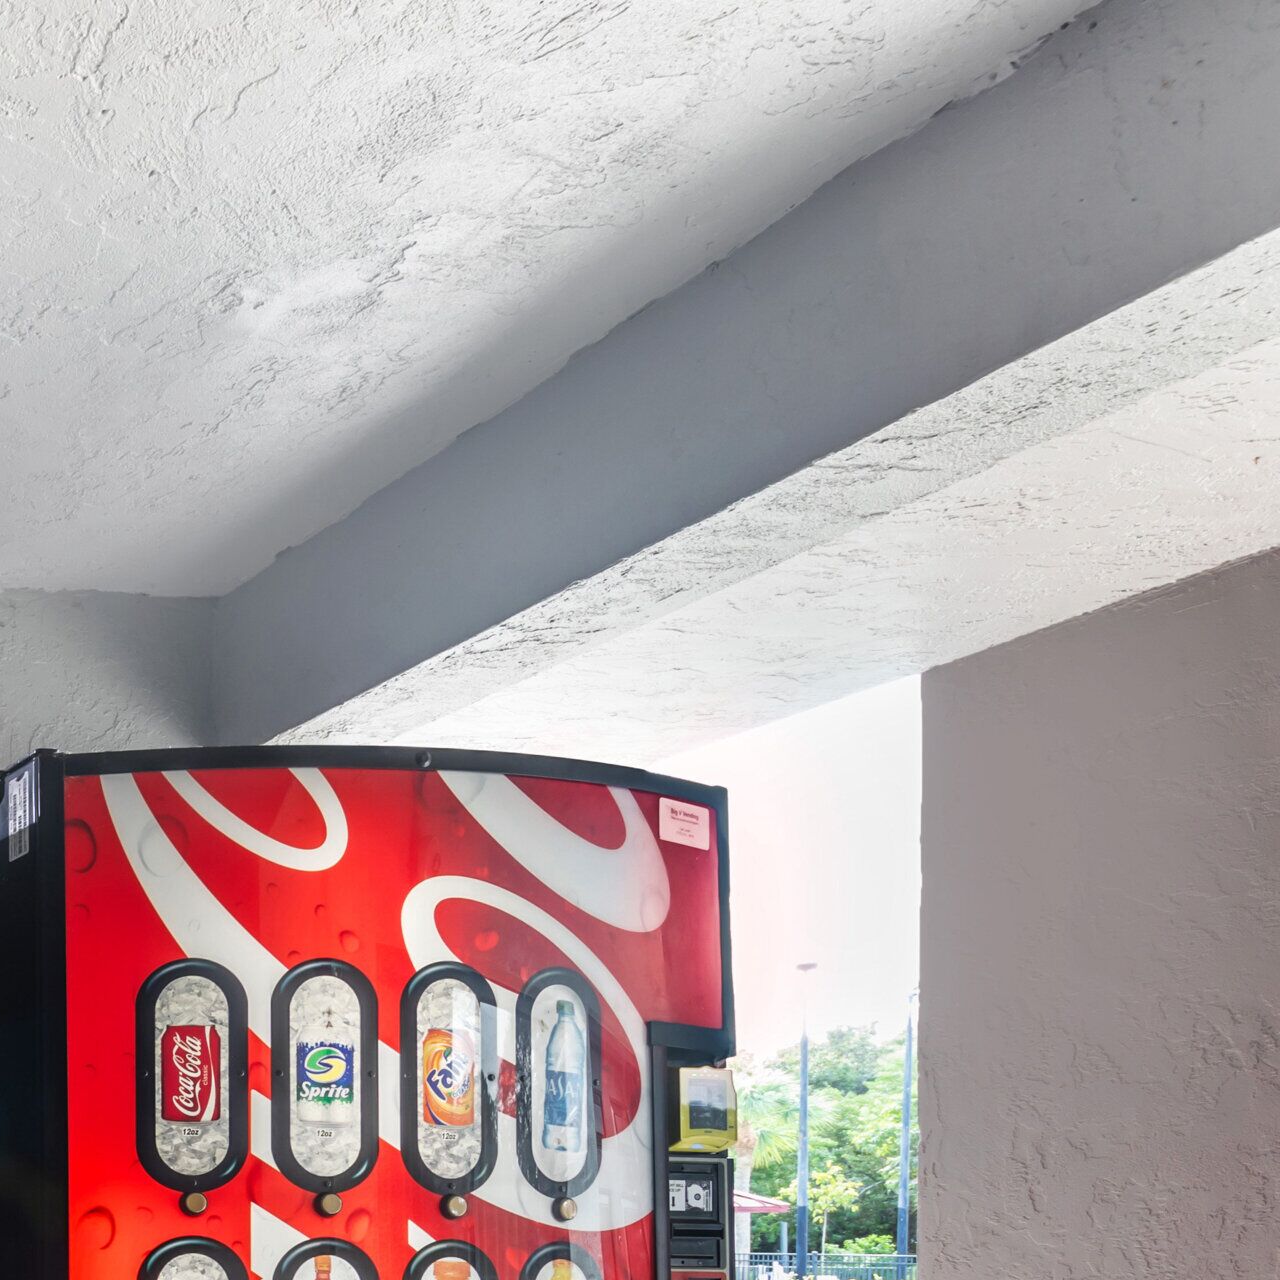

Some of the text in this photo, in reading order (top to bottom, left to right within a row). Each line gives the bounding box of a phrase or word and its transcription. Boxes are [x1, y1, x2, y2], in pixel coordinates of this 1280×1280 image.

[299, 1081, 351, 1101] Sprite
[182, 1128, 200, 1136] 12oz
[316, 1130, 333, 1138] 12oz
[441, 1132, 457, 1140] 12oz
